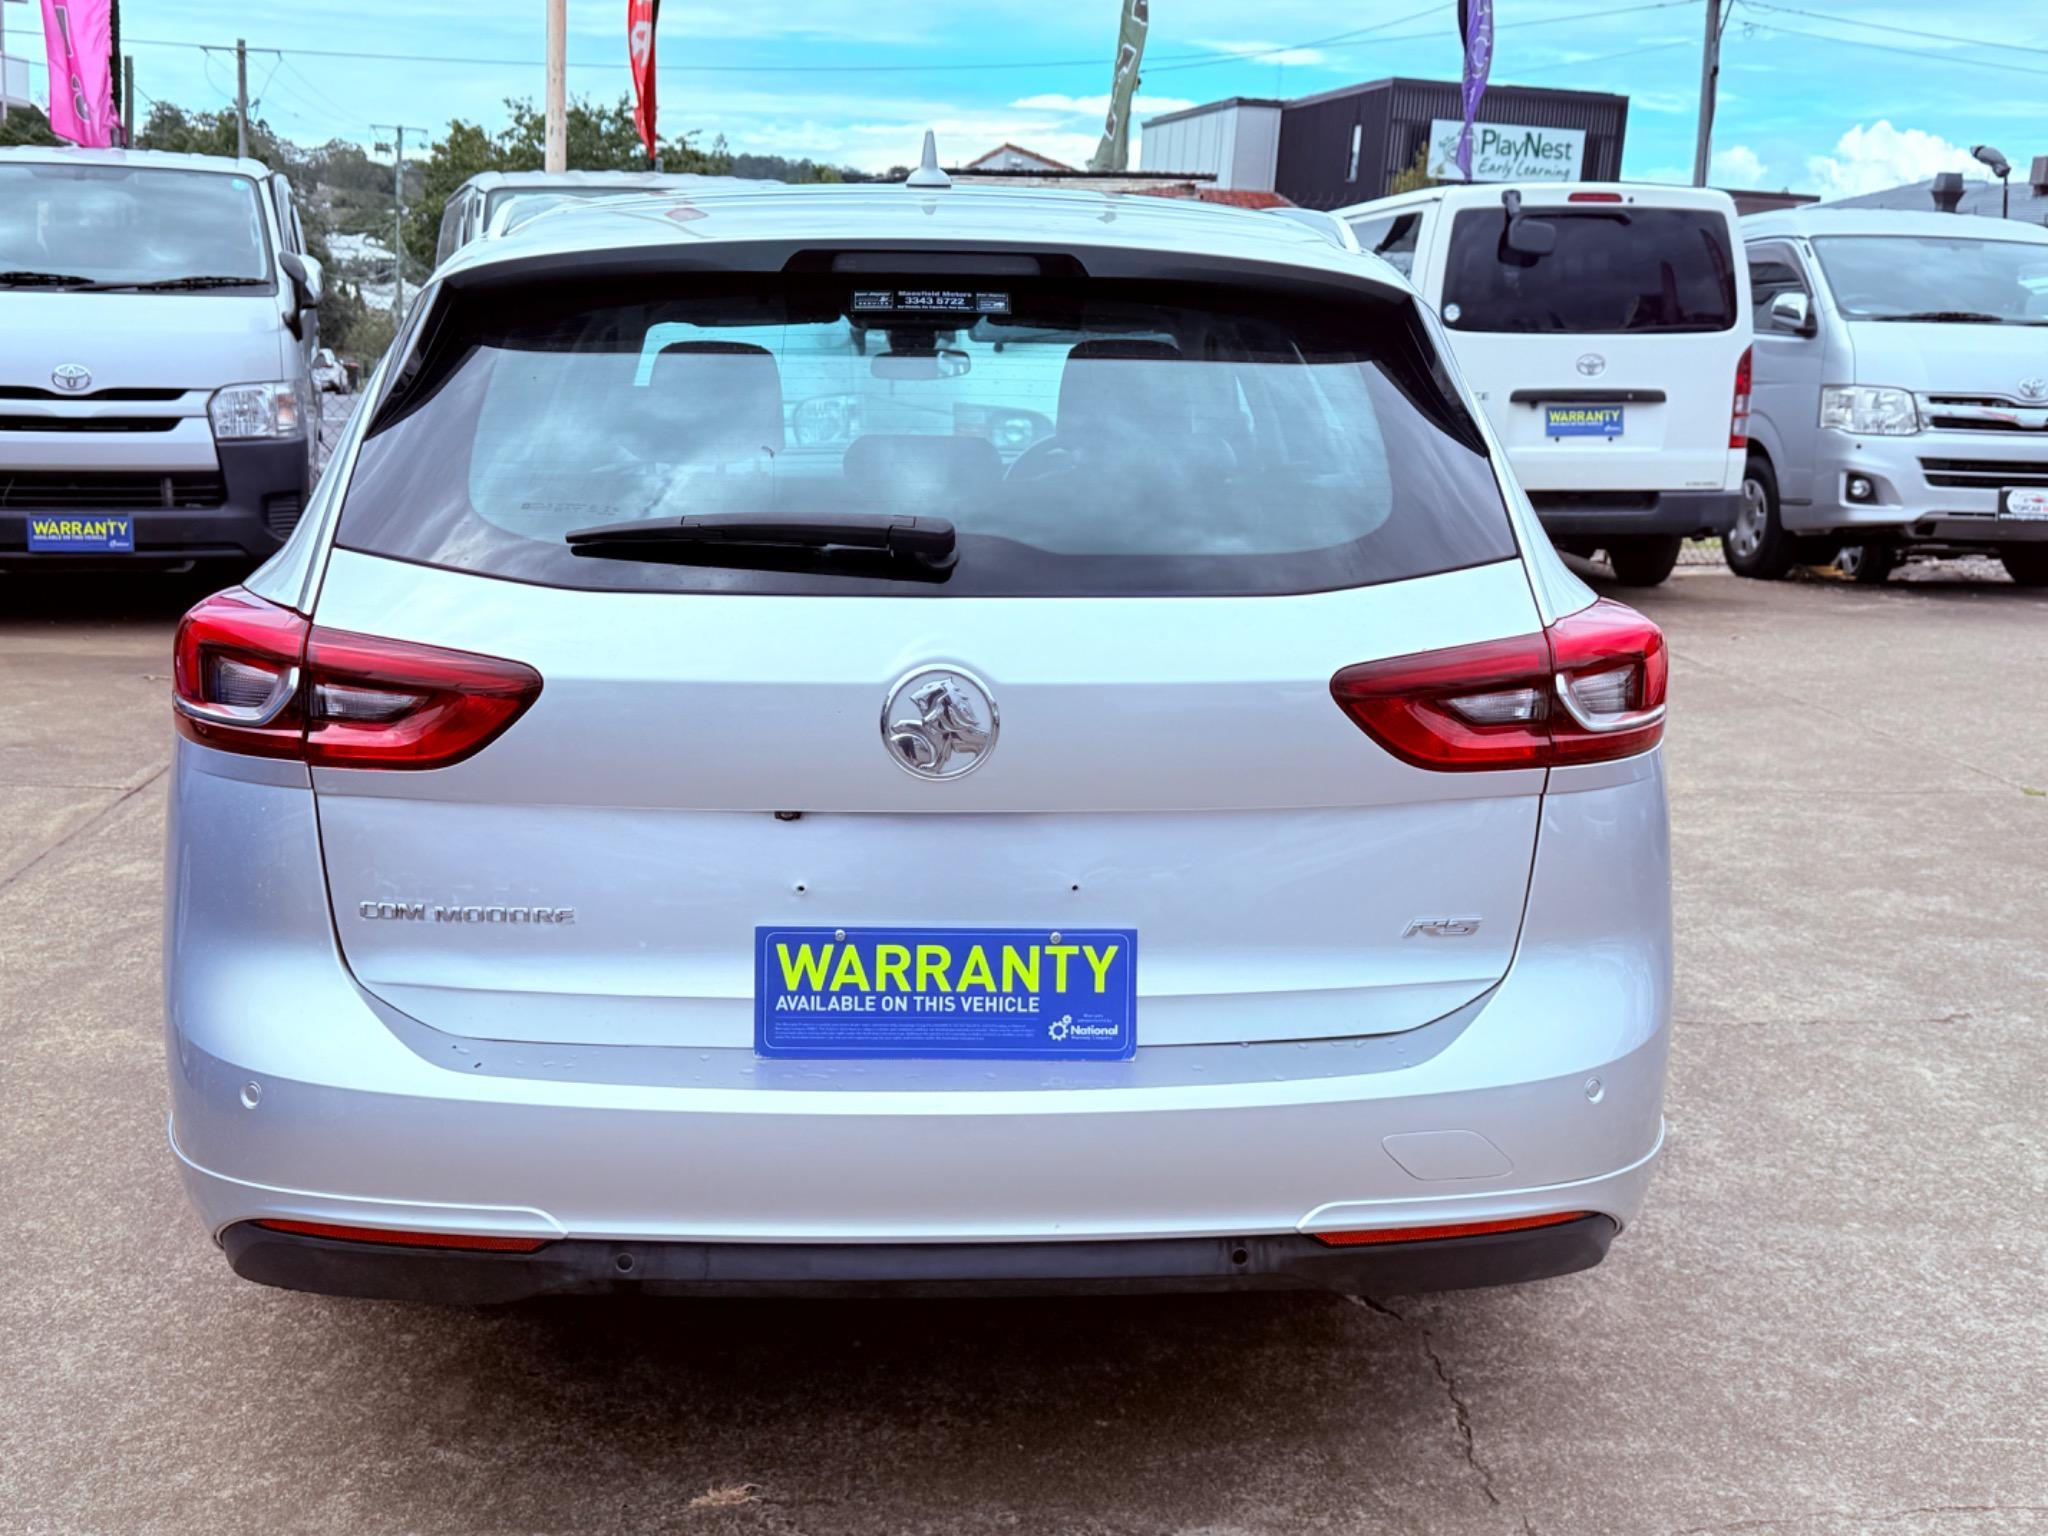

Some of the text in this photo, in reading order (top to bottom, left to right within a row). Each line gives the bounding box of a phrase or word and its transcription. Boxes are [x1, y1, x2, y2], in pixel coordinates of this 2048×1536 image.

[1480, 129, 1573, 161] PlayNest
[1478, 157, 1571, 181] Early Learning
[904, 296, 933, 305] 3343
[1549, 410, 1620, 423] WARRANTY
[32, 520, 128, 536] WARRANTY
[359, 901, 576, 924] COMMODORE
[1401, 917, 1482, 939] RS
[775, 943, 1119, 994] WARRANTY
[775, 994, 1041, 1014] AVAILABLE ON THIS VEHICLE
[1070, 1024, 1119, 1036] National
